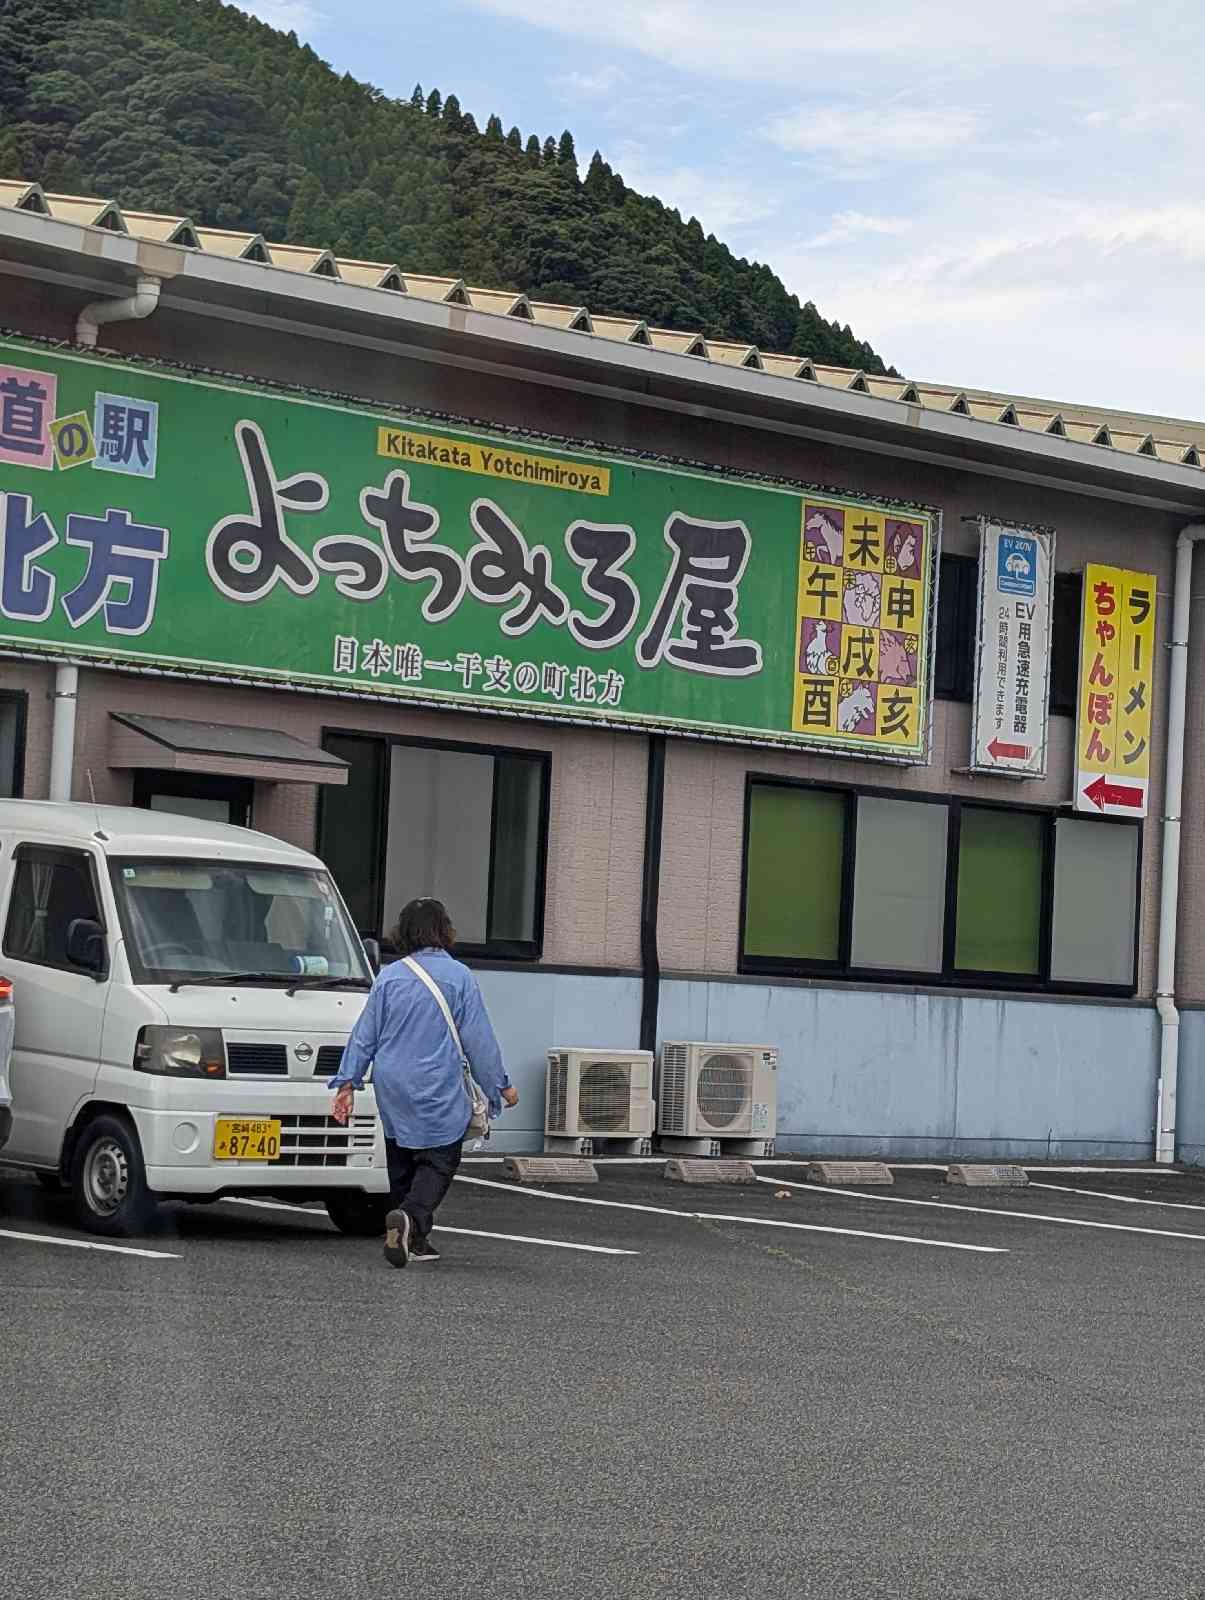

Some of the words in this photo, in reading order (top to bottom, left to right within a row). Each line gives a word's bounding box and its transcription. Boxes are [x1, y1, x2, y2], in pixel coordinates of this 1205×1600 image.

[0, 376, 151, 468] 道の駅
[386, 433, 472, 468] Kitakata
[480, 451, 601, 491] Yotchimiroya
[206, 418, 762, 676] よっちみろ屋
[848, 517, 880, 567] 未
[806, 565, 838, 616] 午
[887, 579, 915, 628] 申
[334, 635, 624, 704] 日本唯一干支の町北方
[842, 628, 875, 678] 戌
[1014, 601, 1036, 734] EV用急速充電器
[1085, 581, 1116, 763] ちゃんぽん
[1123, 588, 1151, 765] ラーメン
[802, 679, 835, 728] 酉
[880, 688, 913, 739] 亥
